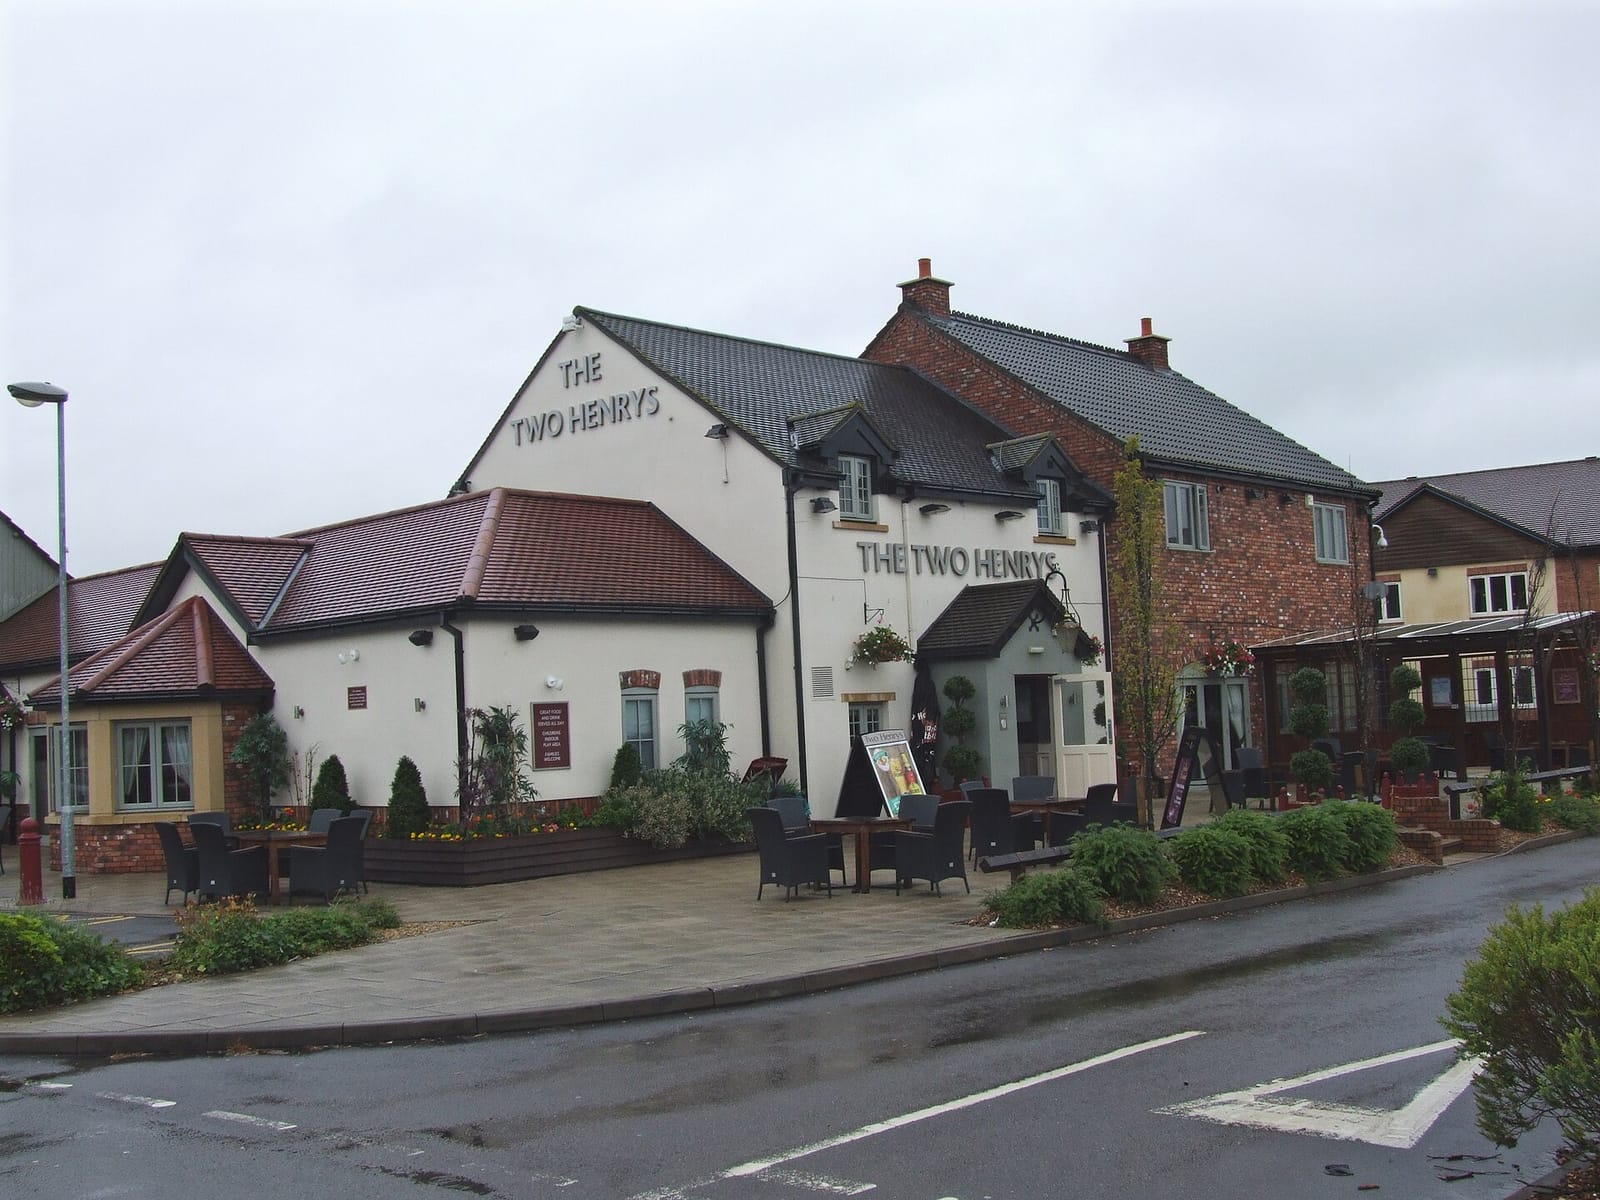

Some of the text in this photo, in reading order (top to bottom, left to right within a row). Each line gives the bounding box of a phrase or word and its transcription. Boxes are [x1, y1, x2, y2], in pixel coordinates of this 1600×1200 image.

[559, 352, 602, 389] THE
[511, 386, 660, 446] TWO HENRYS
[857, 541, 1057, 580] THE TWO HENRYS
[864, 735, 879, 743] Two
